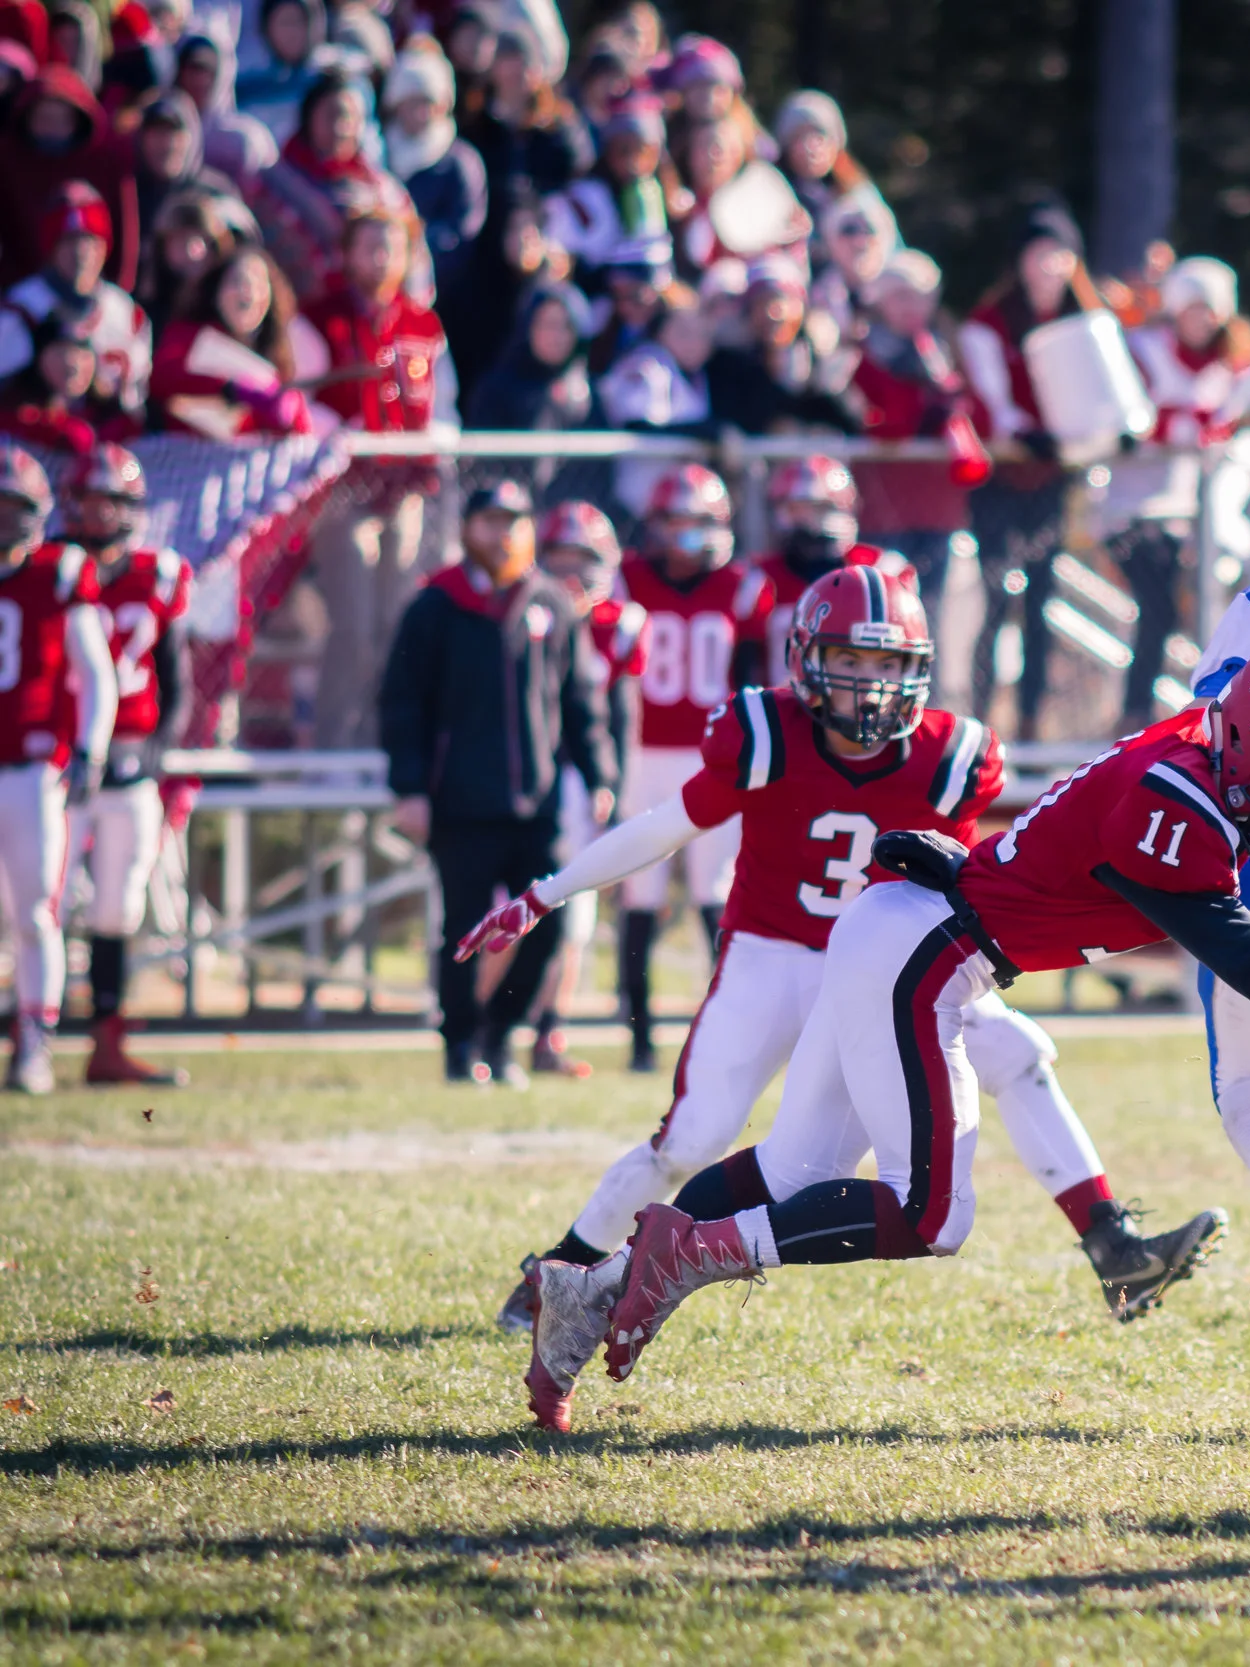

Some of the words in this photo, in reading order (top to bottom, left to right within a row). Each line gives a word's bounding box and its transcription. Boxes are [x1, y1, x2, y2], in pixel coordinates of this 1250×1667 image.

[641, 609, 735, 708] 80
[796, 809, 879, 917] 3
[1136, 809, 1188, 867] 11
